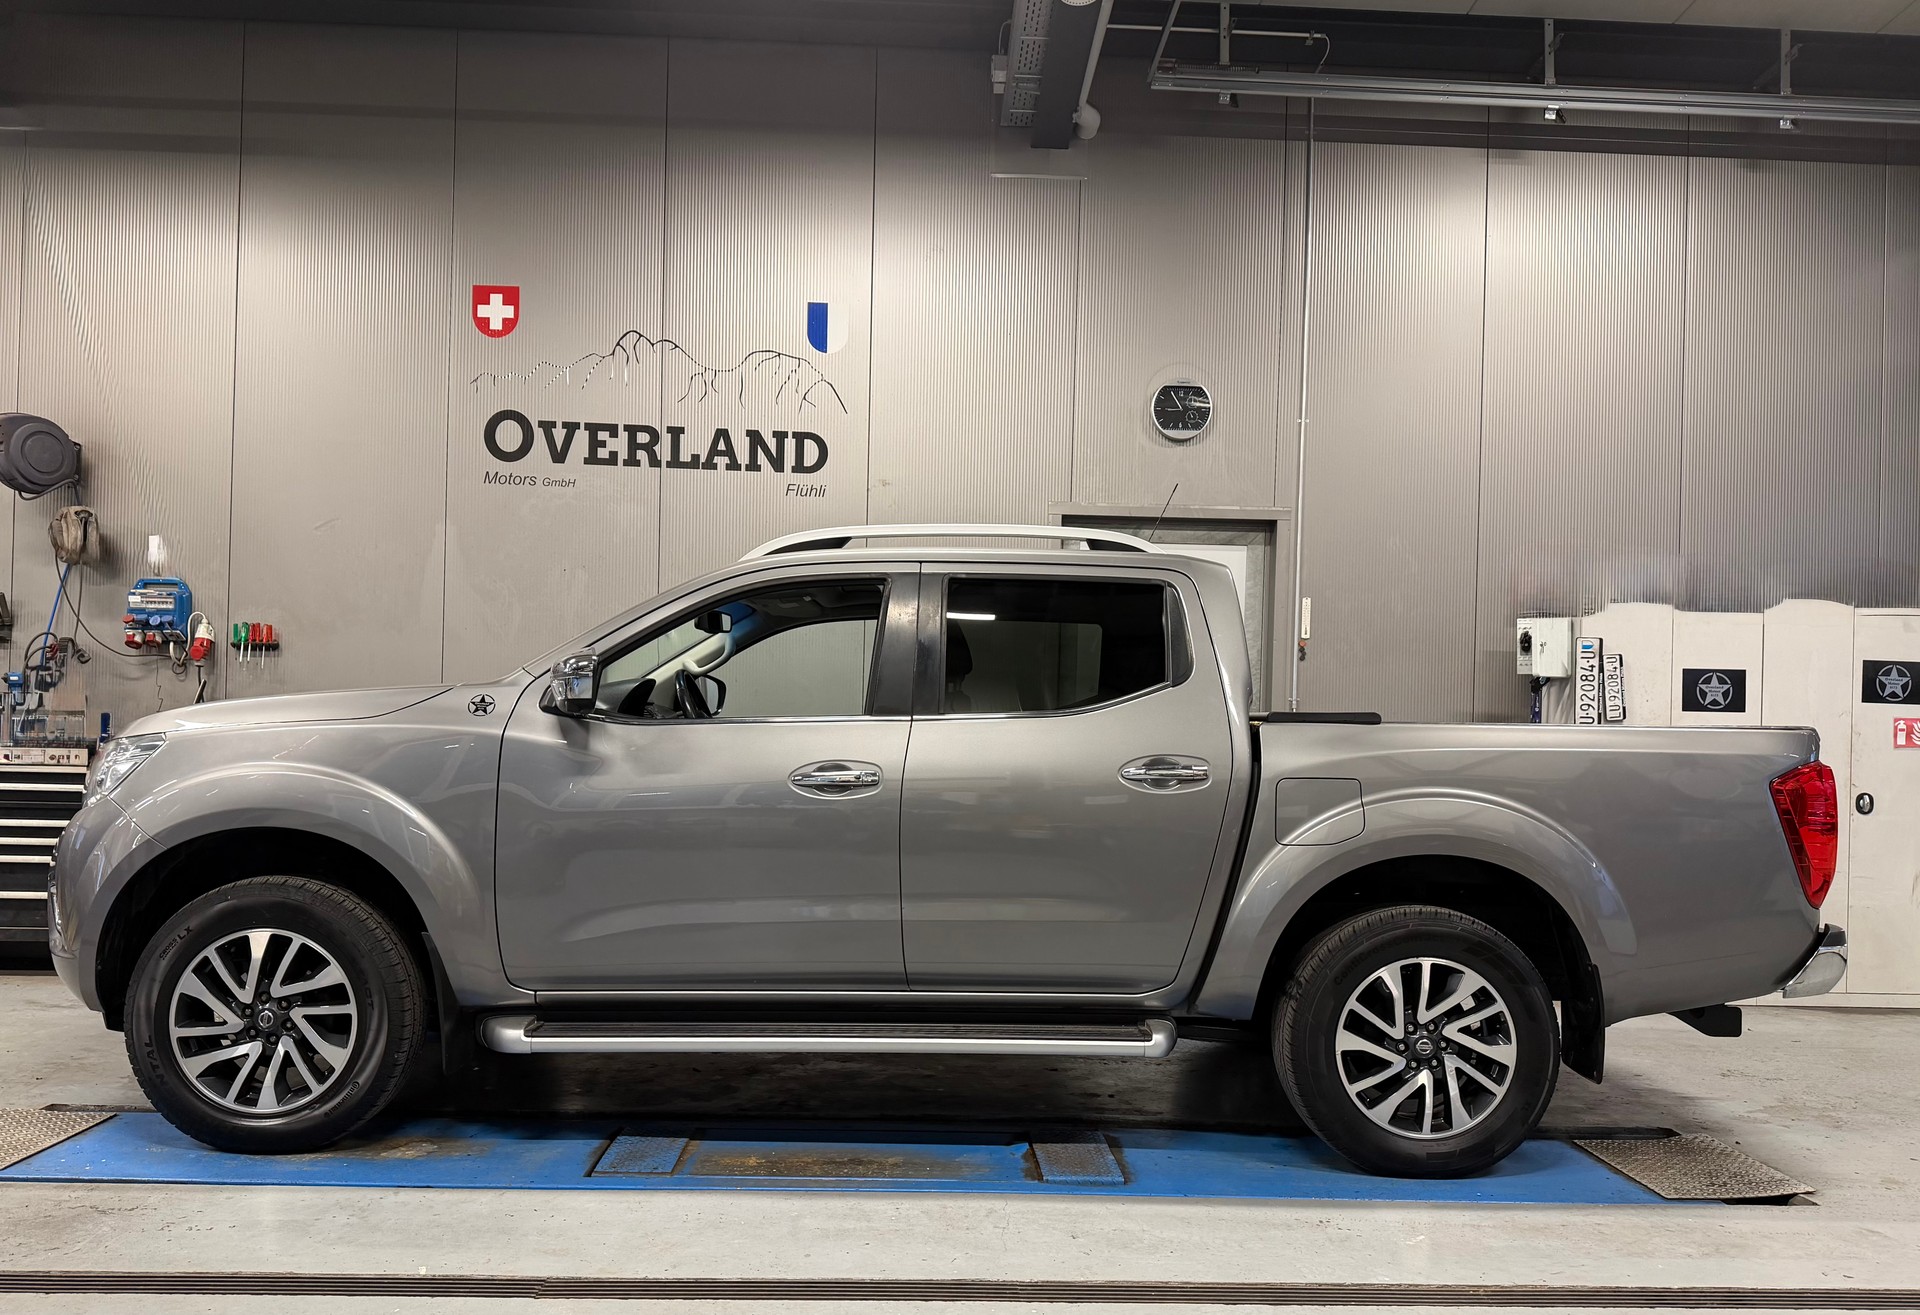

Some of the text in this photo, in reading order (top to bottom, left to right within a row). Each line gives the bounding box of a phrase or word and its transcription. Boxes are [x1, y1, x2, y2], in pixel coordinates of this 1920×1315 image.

[483, 470, 577, 488] Motors GmbH
[785, 483, 827, 498] Flühli
